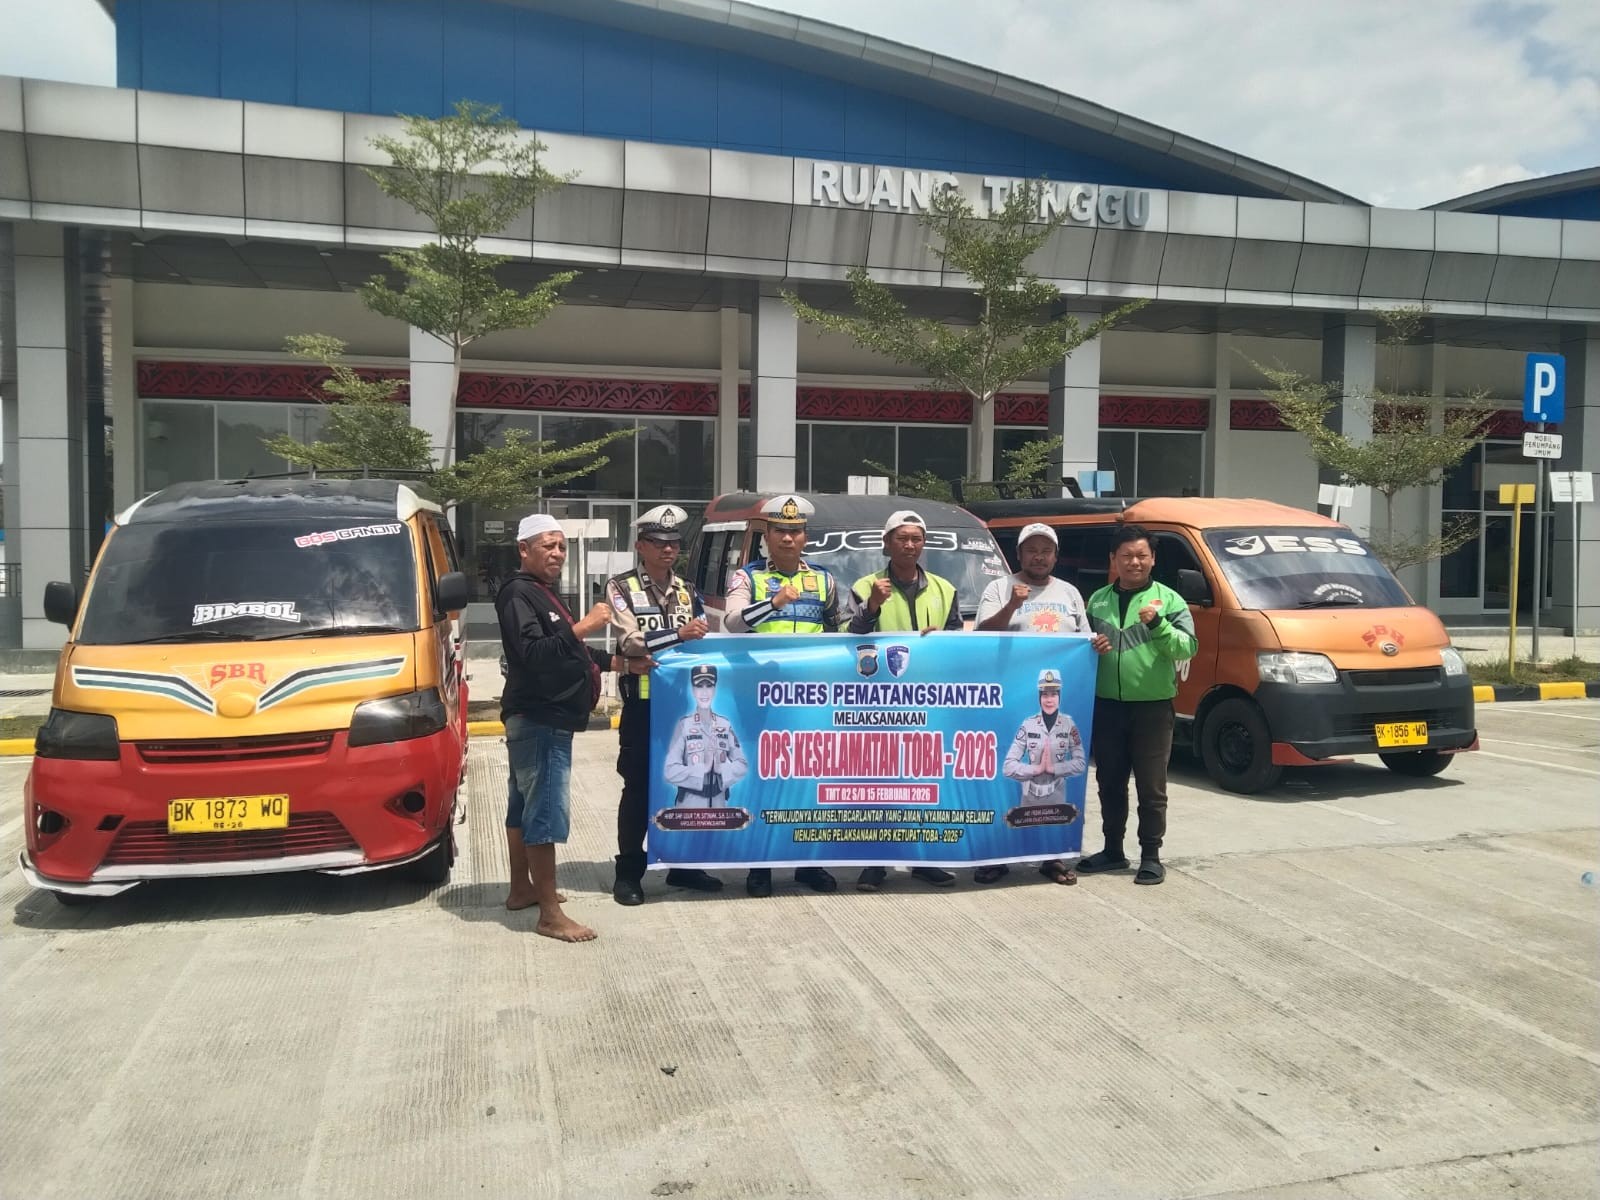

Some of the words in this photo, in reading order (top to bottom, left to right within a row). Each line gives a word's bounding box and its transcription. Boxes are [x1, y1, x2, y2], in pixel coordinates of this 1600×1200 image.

[812, 162, 960, 214] RUANG
[1533, 363, 1556, 413] P
[337, 524, 401, 540] BANDIT
[801, 530, 958, 555] JES
[1225, 535, 1368, 556] JESS
[192, 602, 301, 625] BIMBOL
[1361, 625, 1404, 648] SBR
[210, 662, 267, 688] SBR
[759, 683, 829, 706] POLRES
[832, 683, 1002, 707] PEMATANGSIANTAR
[833, 711, 926, 726] MELAKSANAKAN
[1391, 725, 1409, 738] 1856
[759, 731, 791, 778] OPS
[794, 731, 900, 778] KESELAMATAN
[825, 788, 841, 801] TMT
[841, 788, 851, 801] 02
[852, 788, 866, 801] S/D
[867, 788, 876, 801] 15
[876, 788, 911, 801] FEBRUARI
[911, 788, 931, 801] 2026
[174, 802, 195, 822] BK
[206, 800, 248, 820] 1873
[812, 810, 884, 823] KAMSELTIBCARLANTAR
[885, 810, 902, 822] YANG
[902, 810, 923, 824] AMAN,
[924, 810, 951, 823] NYAMAN
[951, 811, 965, 823] DAN
[965, 811, 995, 824] SELAMAT
[794, 828, 832, 842] MENJELANG
[832, 828, 878, 842] PELAKSANAAN
[879, 828, 892, 842] OPS
[892, 829, 921, 842] KETUPAT
